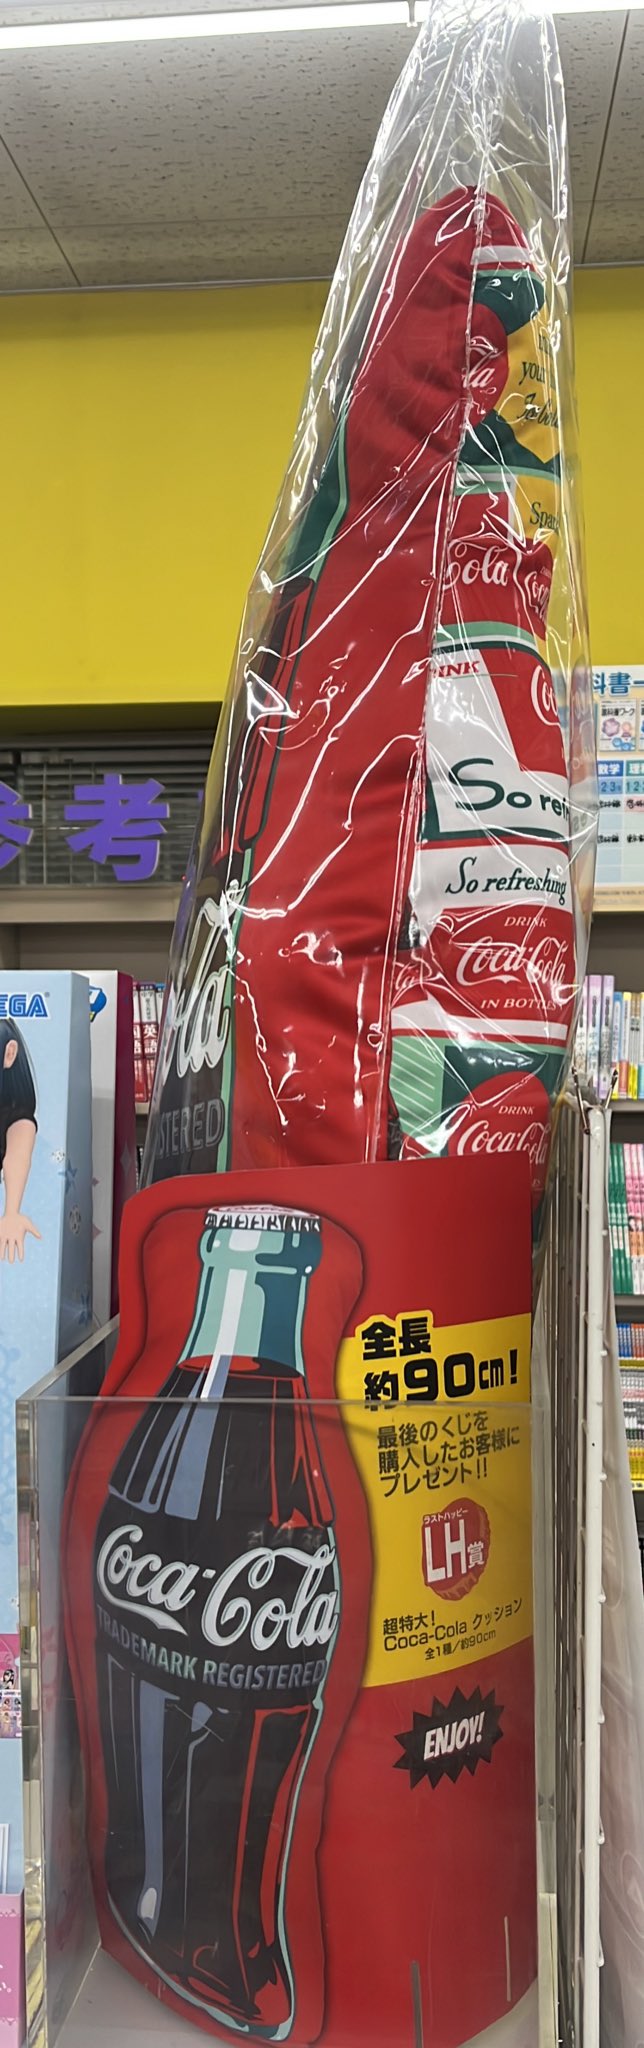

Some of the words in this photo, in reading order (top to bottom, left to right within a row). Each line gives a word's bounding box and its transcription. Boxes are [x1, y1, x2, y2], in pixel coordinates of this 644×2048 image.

[448, 758, 532, 811] So
[445, 856, 479, 894] So
[482, 868, 567, 905] refreshing
[504, 917, 547, 928] DRINK
[480, 999, 500, 1009] IN
[498, 1105, 534, 1115] DRINK
[362, 1316, 432, 1361] 全長
[377, 1410, 488, 1450] 最後のくじを
[378, 1426, 520, 1475] 購入したお客様に
[424, 1508, 468, 1525] ラストハッピー
[425, 1519, 484, 1583] LH賞
[97, 1524, 338, 1651] Coca-Cola
[383, 1610, 436, 1635] 超特大!
[384, 1621, 467, 1651] Coca-Cola
[473, 1597, 523, 1630] クッション
[96, 1604, 198, 1681] TRADEMARK
[203, 1658, 329, 1691] REGISTERED
[423, 1711, 486, 1761] ENJOY!
